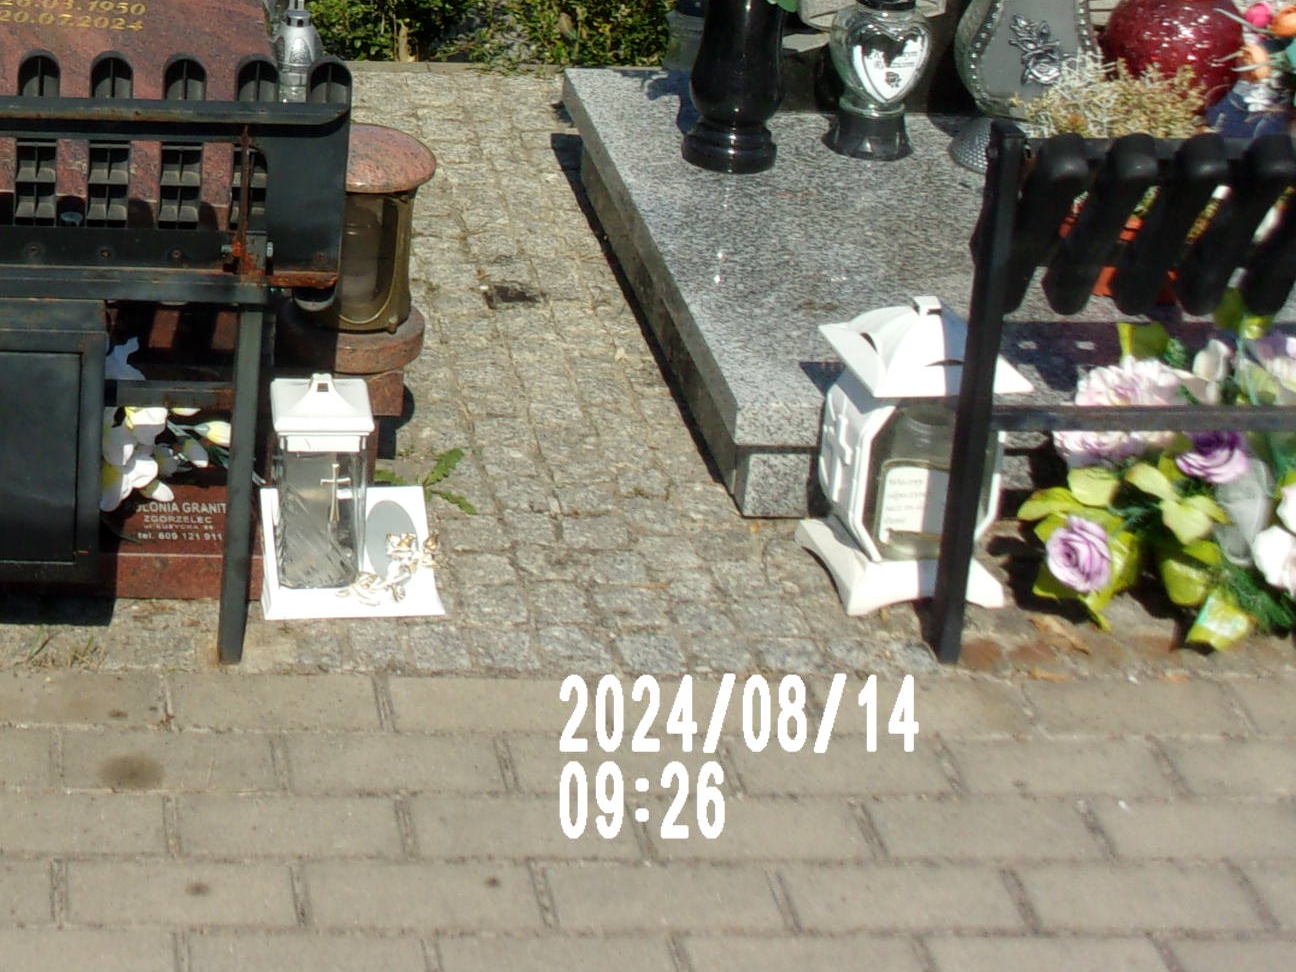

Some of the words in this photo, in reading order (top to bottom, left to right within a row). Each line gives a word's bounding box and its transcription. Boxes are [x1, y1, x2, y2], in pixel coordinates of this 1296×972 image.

[143, 515, 213, 525] ZGORZELEC
[158, 531, 179, 540] 609
[204, 532, 223, 541] 911
